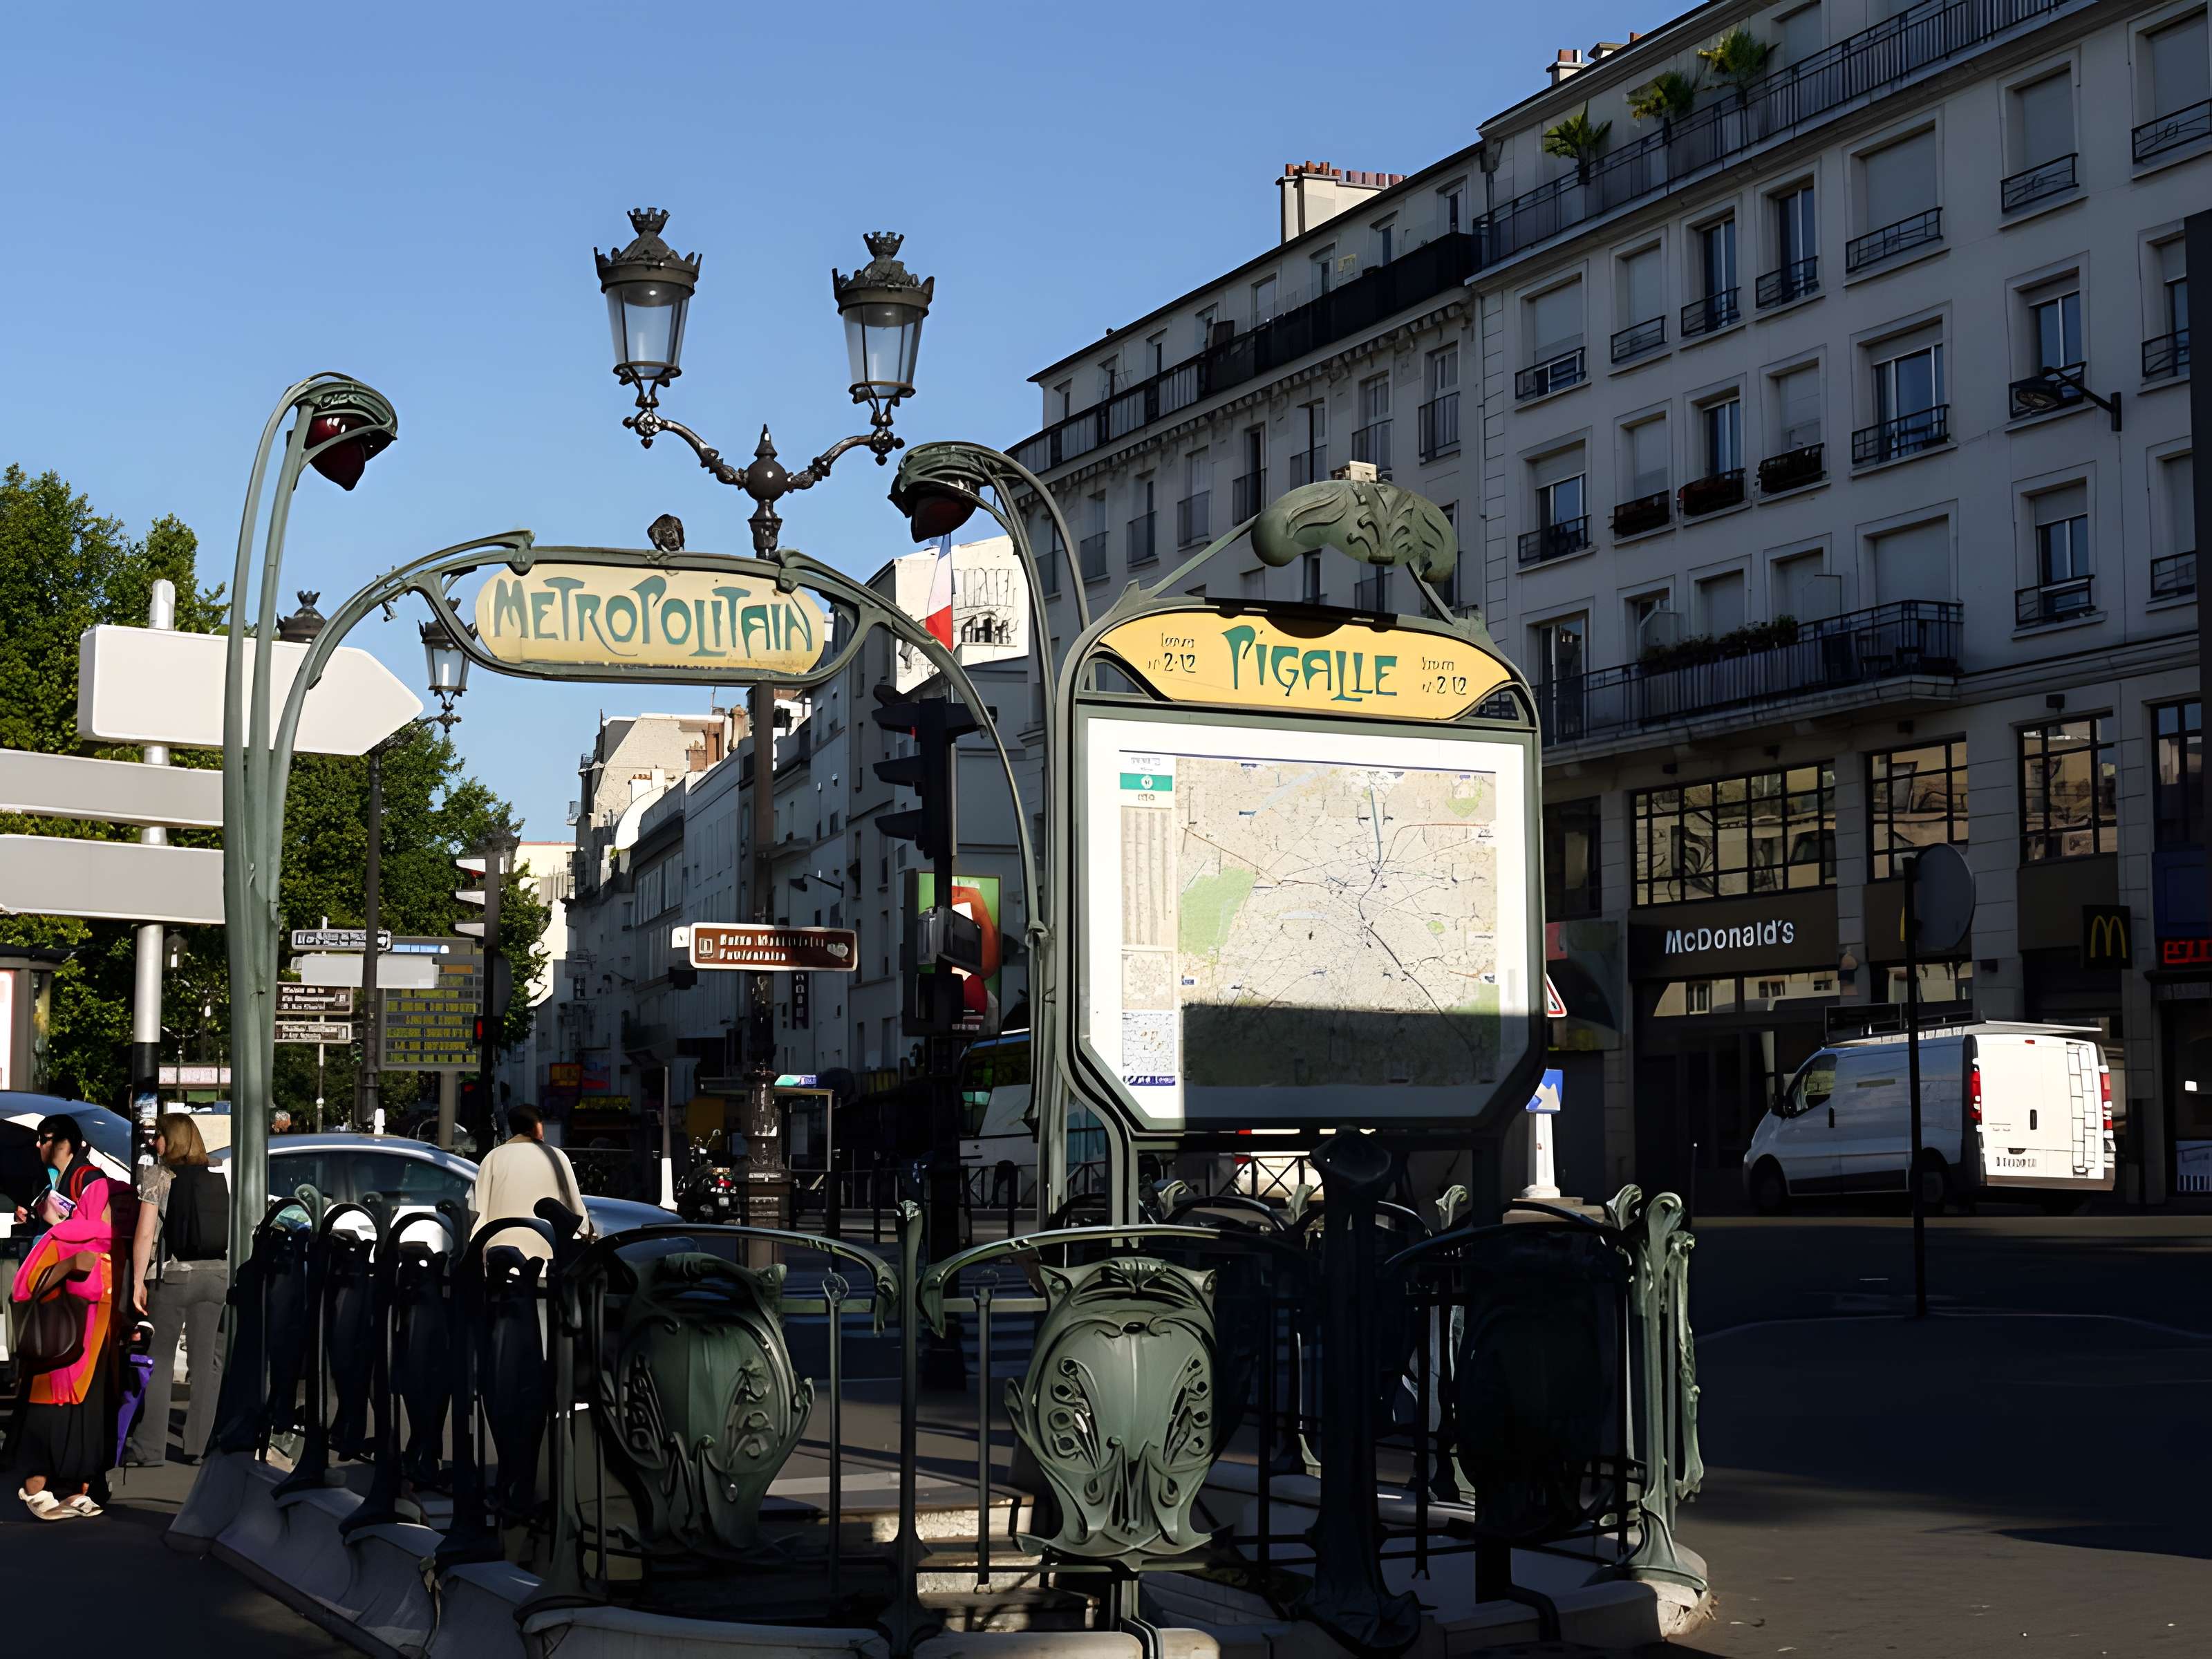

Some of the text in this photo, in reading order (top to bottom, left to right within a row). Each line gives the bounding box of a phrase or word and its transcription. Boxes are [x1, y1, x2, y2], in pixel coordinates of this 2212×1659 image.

[493, 574, 813, 659] METROPOLITAIN
[1221, 625, 1398, 702] PIGALLE
[1665, 919, 1795, 954] McDonald's
